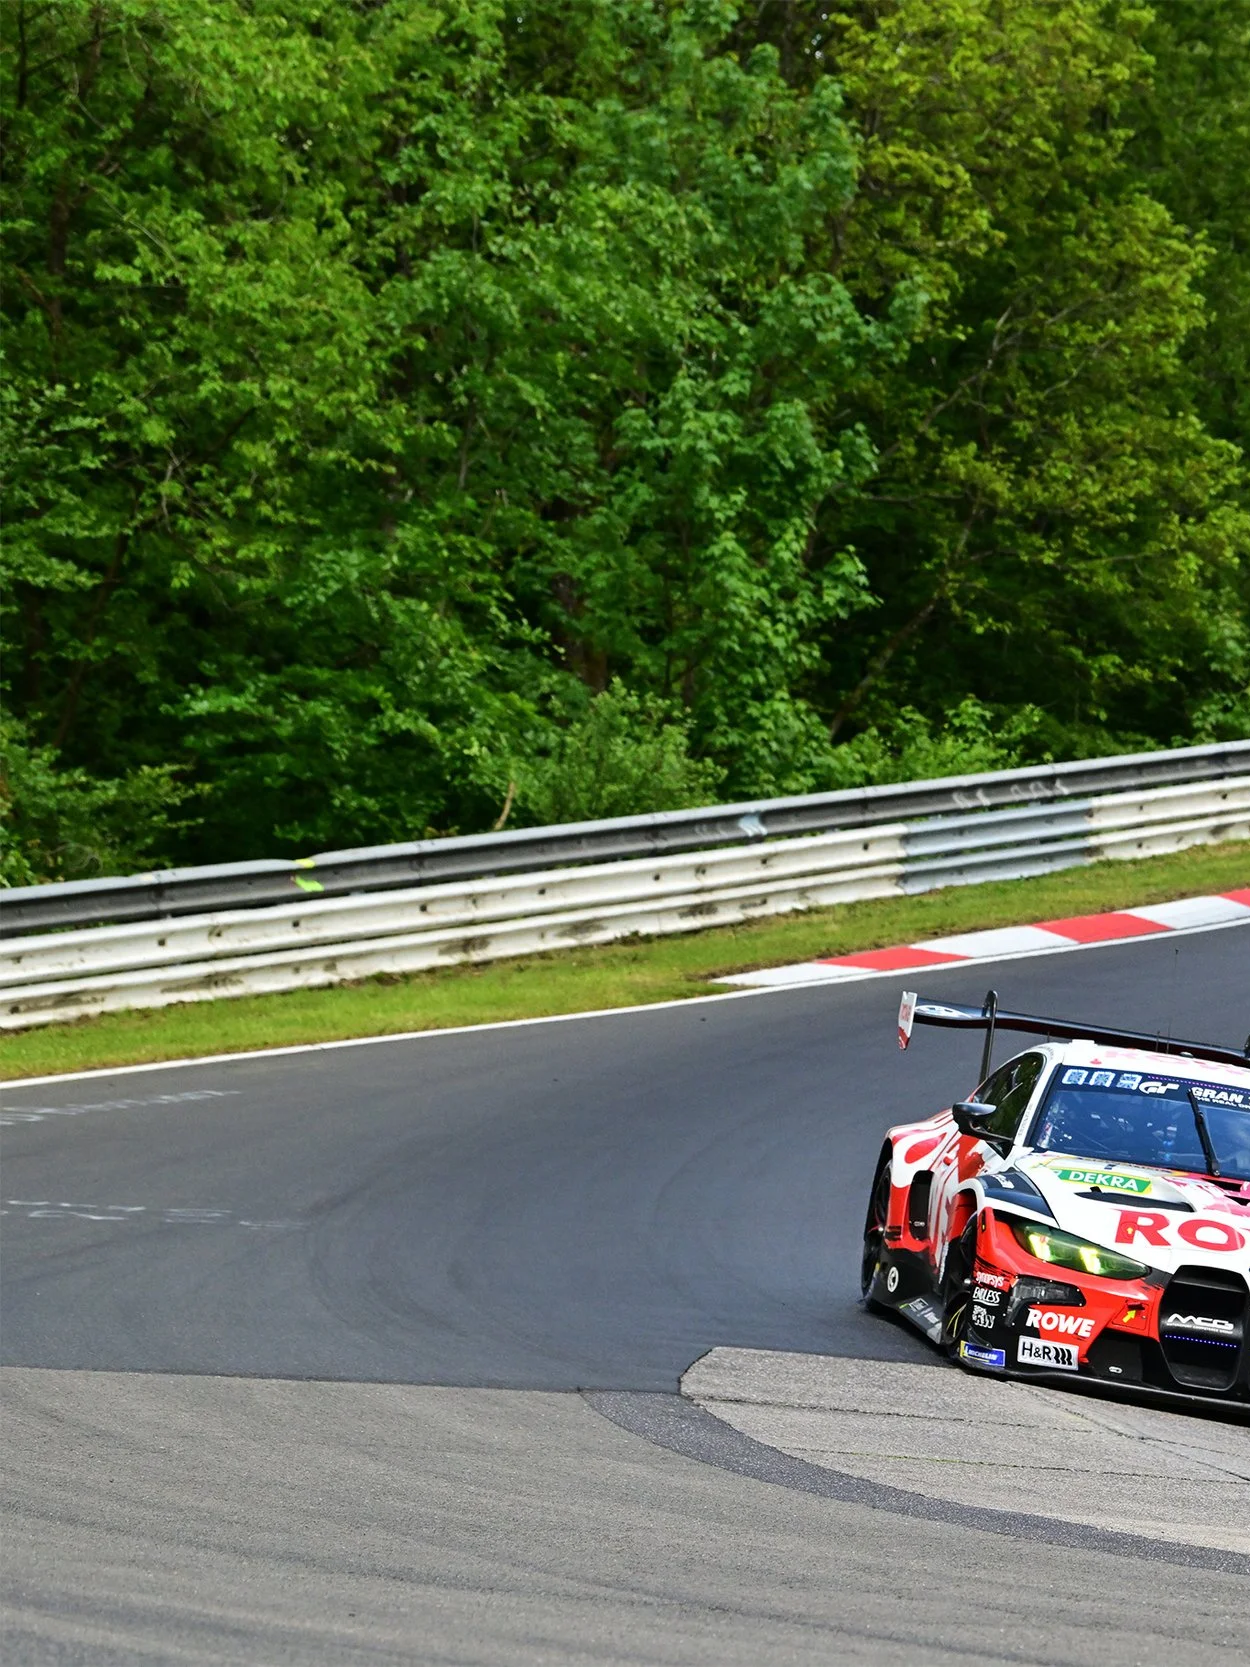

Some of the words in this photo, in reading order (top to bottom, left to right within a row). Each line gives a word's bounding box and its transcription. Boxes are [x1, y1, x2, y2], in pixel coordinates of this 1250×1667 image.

[1191, 1086, 1243, 1104] GRAN
[1068, 1171, 1139, 1191] DEKRA
[1026, 1308, 1096, 1338] ROWE
[1021, 1341, 1052, 1361] H&R
